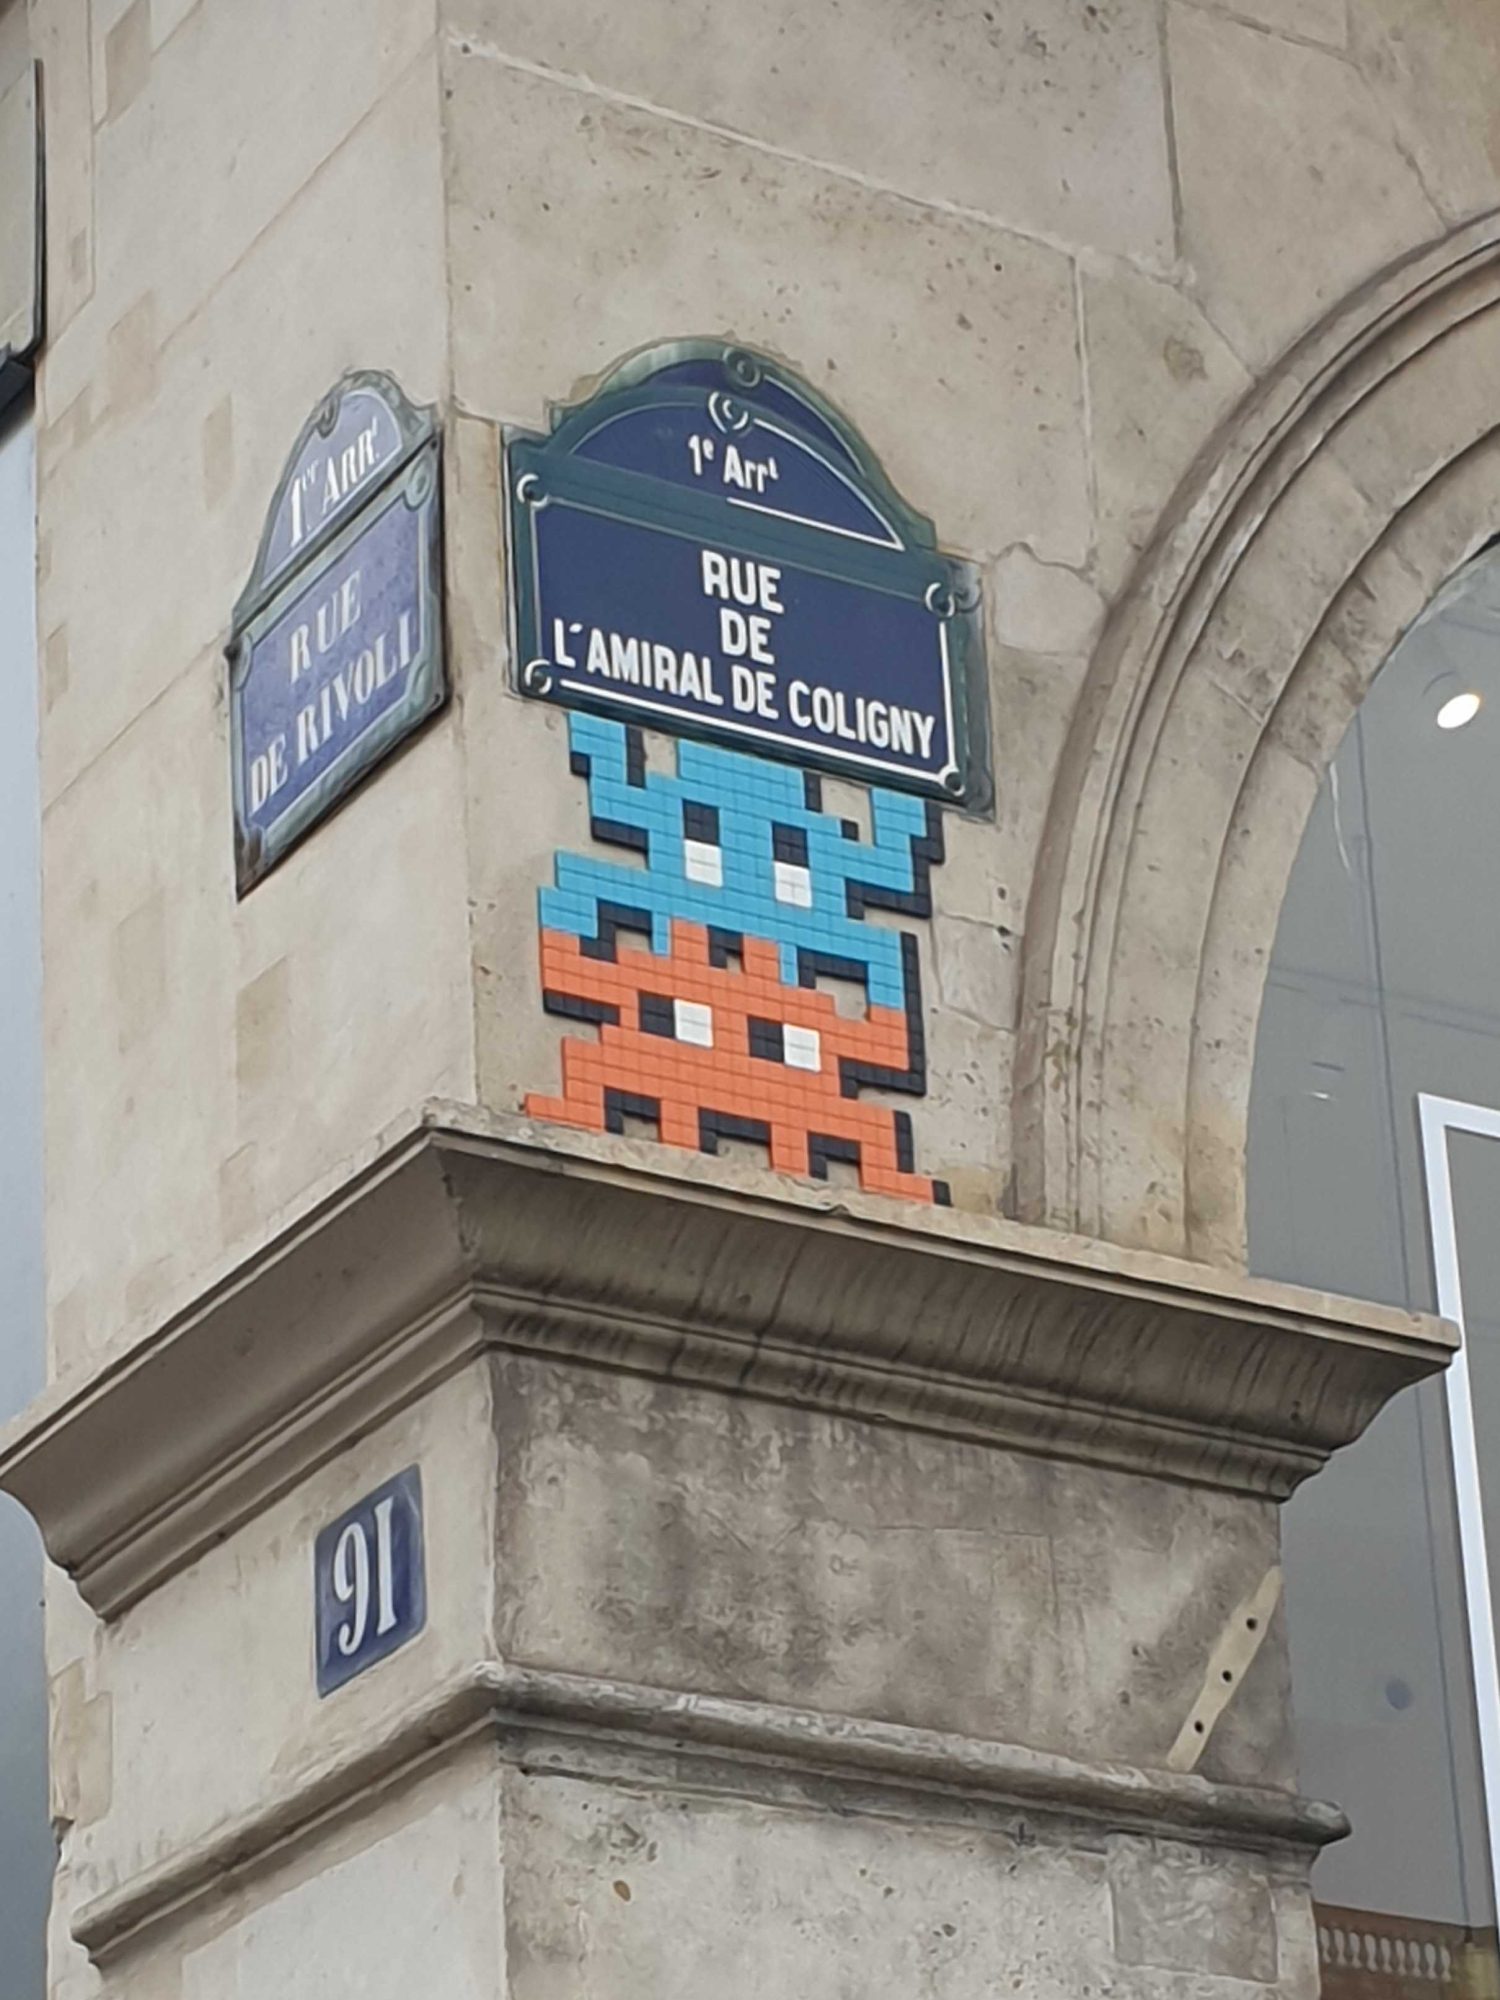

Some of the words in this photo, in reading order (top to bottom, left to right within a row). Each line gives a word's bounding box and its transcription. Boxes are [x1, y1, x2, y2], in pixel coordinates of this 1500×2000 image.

[289, 570, 362, 685] RUE
[702, 549, 784, 614] RUE
[720, 608, 776, 665] DE
[249, 733, 289, 812] DE
[297, 607, 415, 766] RIVOLI
[731, 665, 780, 720] DE
[788, 681, 936, 760] COLIGNY
[333, 1495, 398, 1656] 91
